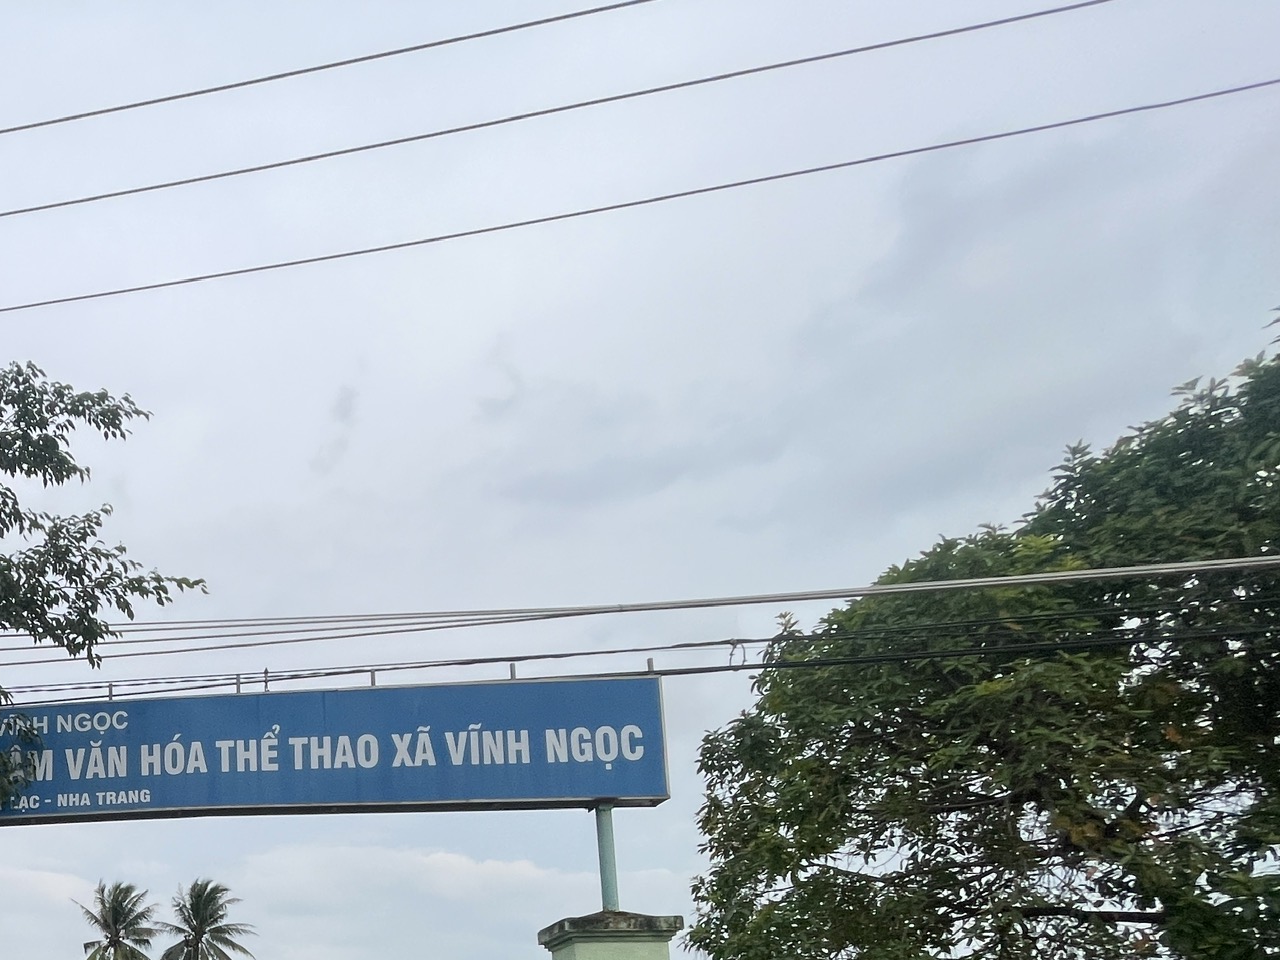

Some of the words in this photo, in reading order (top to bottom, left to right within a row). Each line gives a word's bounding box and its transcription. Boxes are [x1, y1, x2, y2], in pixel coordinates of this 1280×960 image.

[56, 710, 128, 735] NGỌC
[65, 740, 128, 780] VĂN
[140, 733, 208, 776] HÓA
[215, 724, 281, 773] THỂ
[288, 733, 380, 771] THAO
[391, 725, 437, 767] XÃ
[445, 722, 531, 765] VĨNH
[545, 724, 645, 770] NGỌC
[10, 795, 40, 813] LẠC
[57, 793, 91, 807] NHA
[96, 789, 151, 805] TRANG
